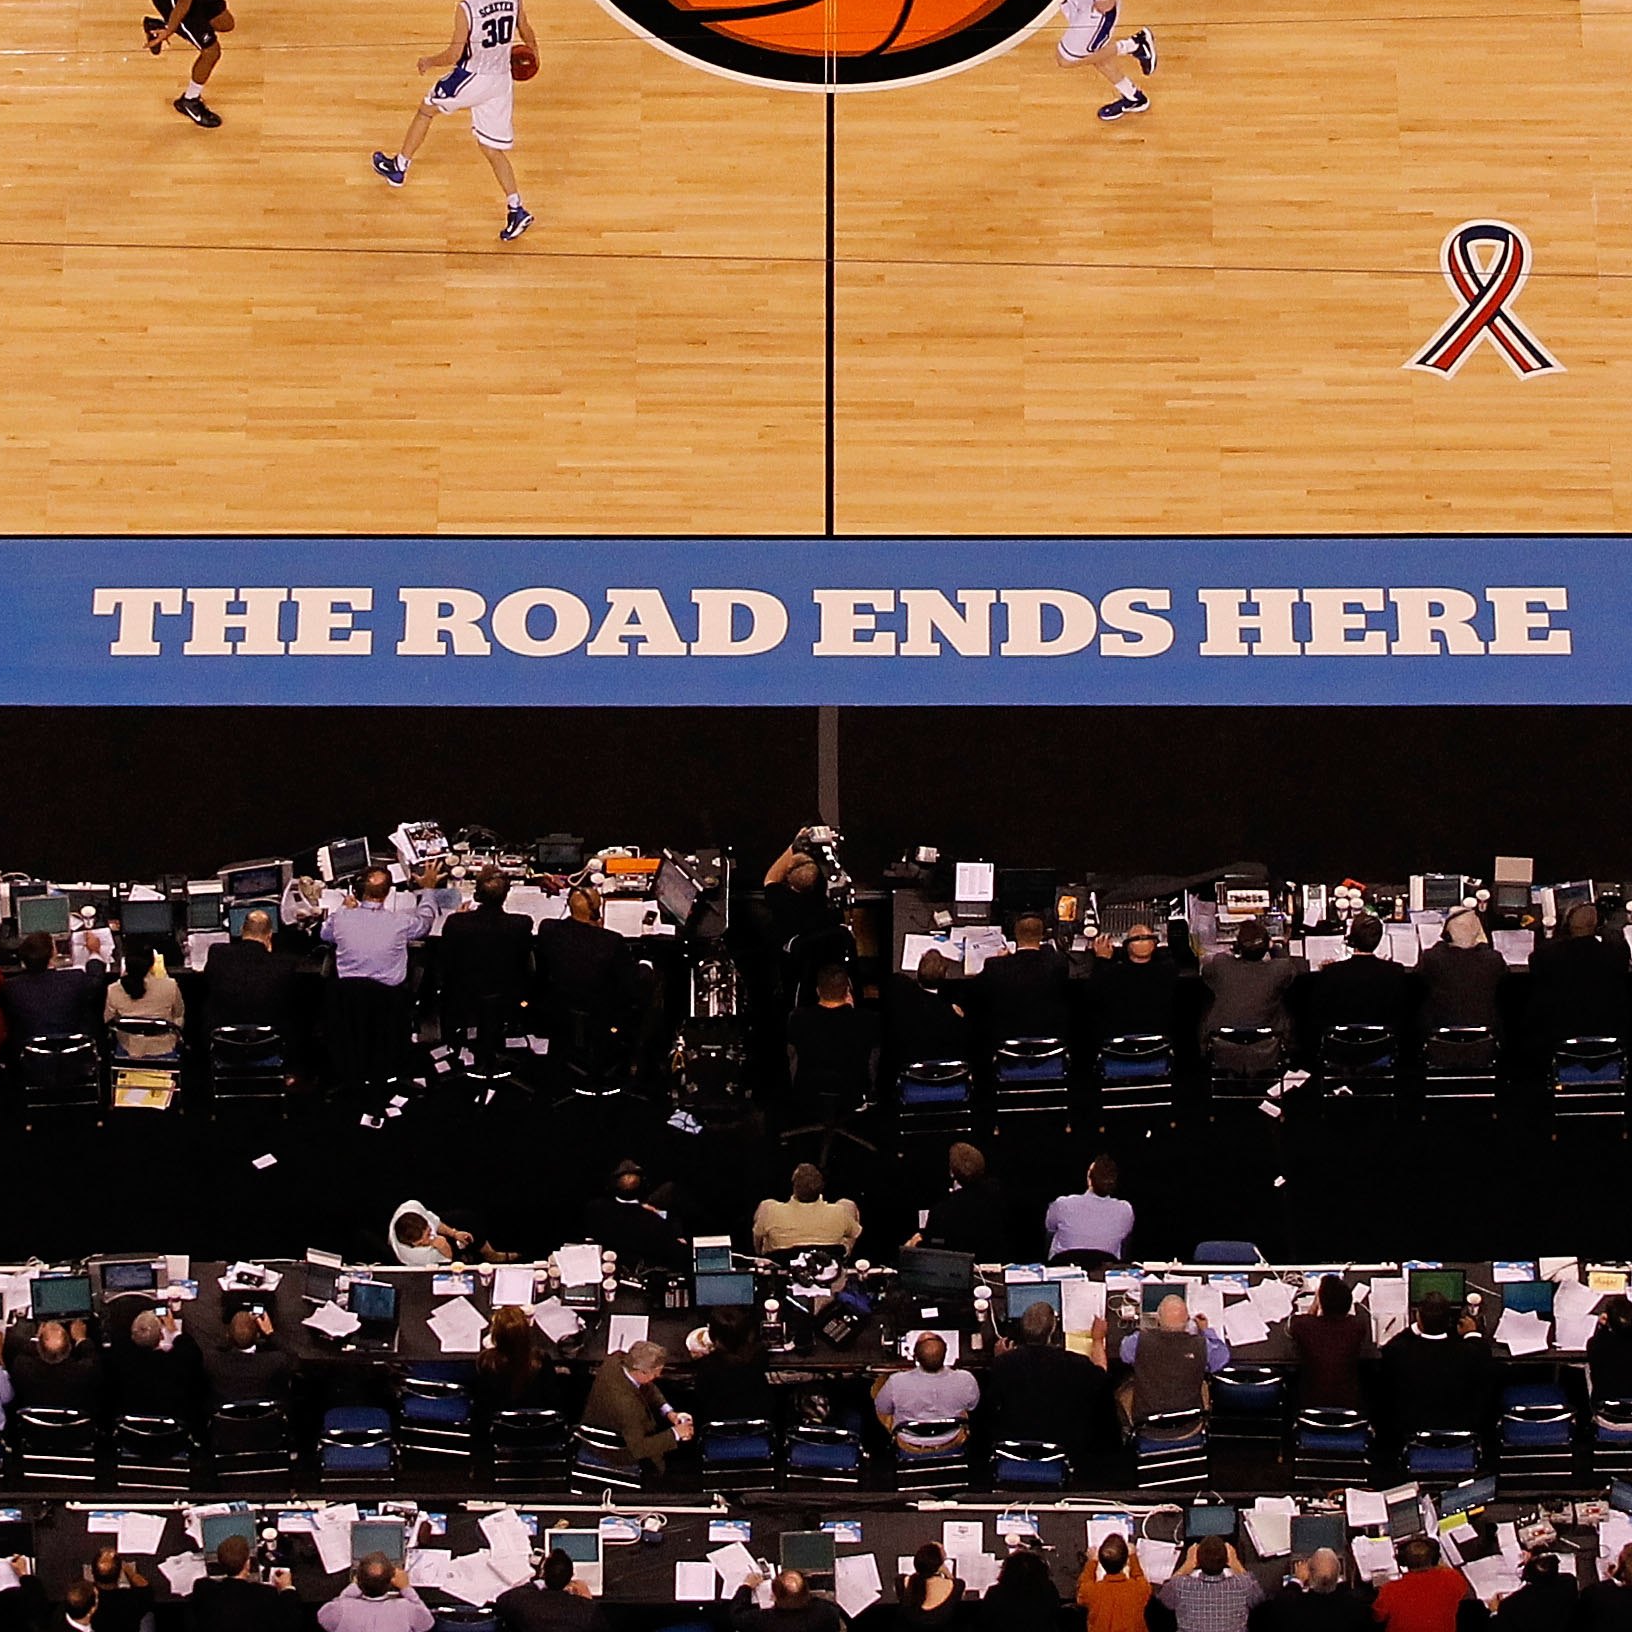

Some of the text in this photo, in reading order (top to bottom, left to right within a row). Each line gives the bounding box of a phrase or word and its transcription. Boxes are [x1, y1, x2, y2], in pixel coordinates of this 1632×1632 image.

[481, 15, 514, 49] 30
[92, 587, 1572, 657] THE ROAD ENDS HERE
